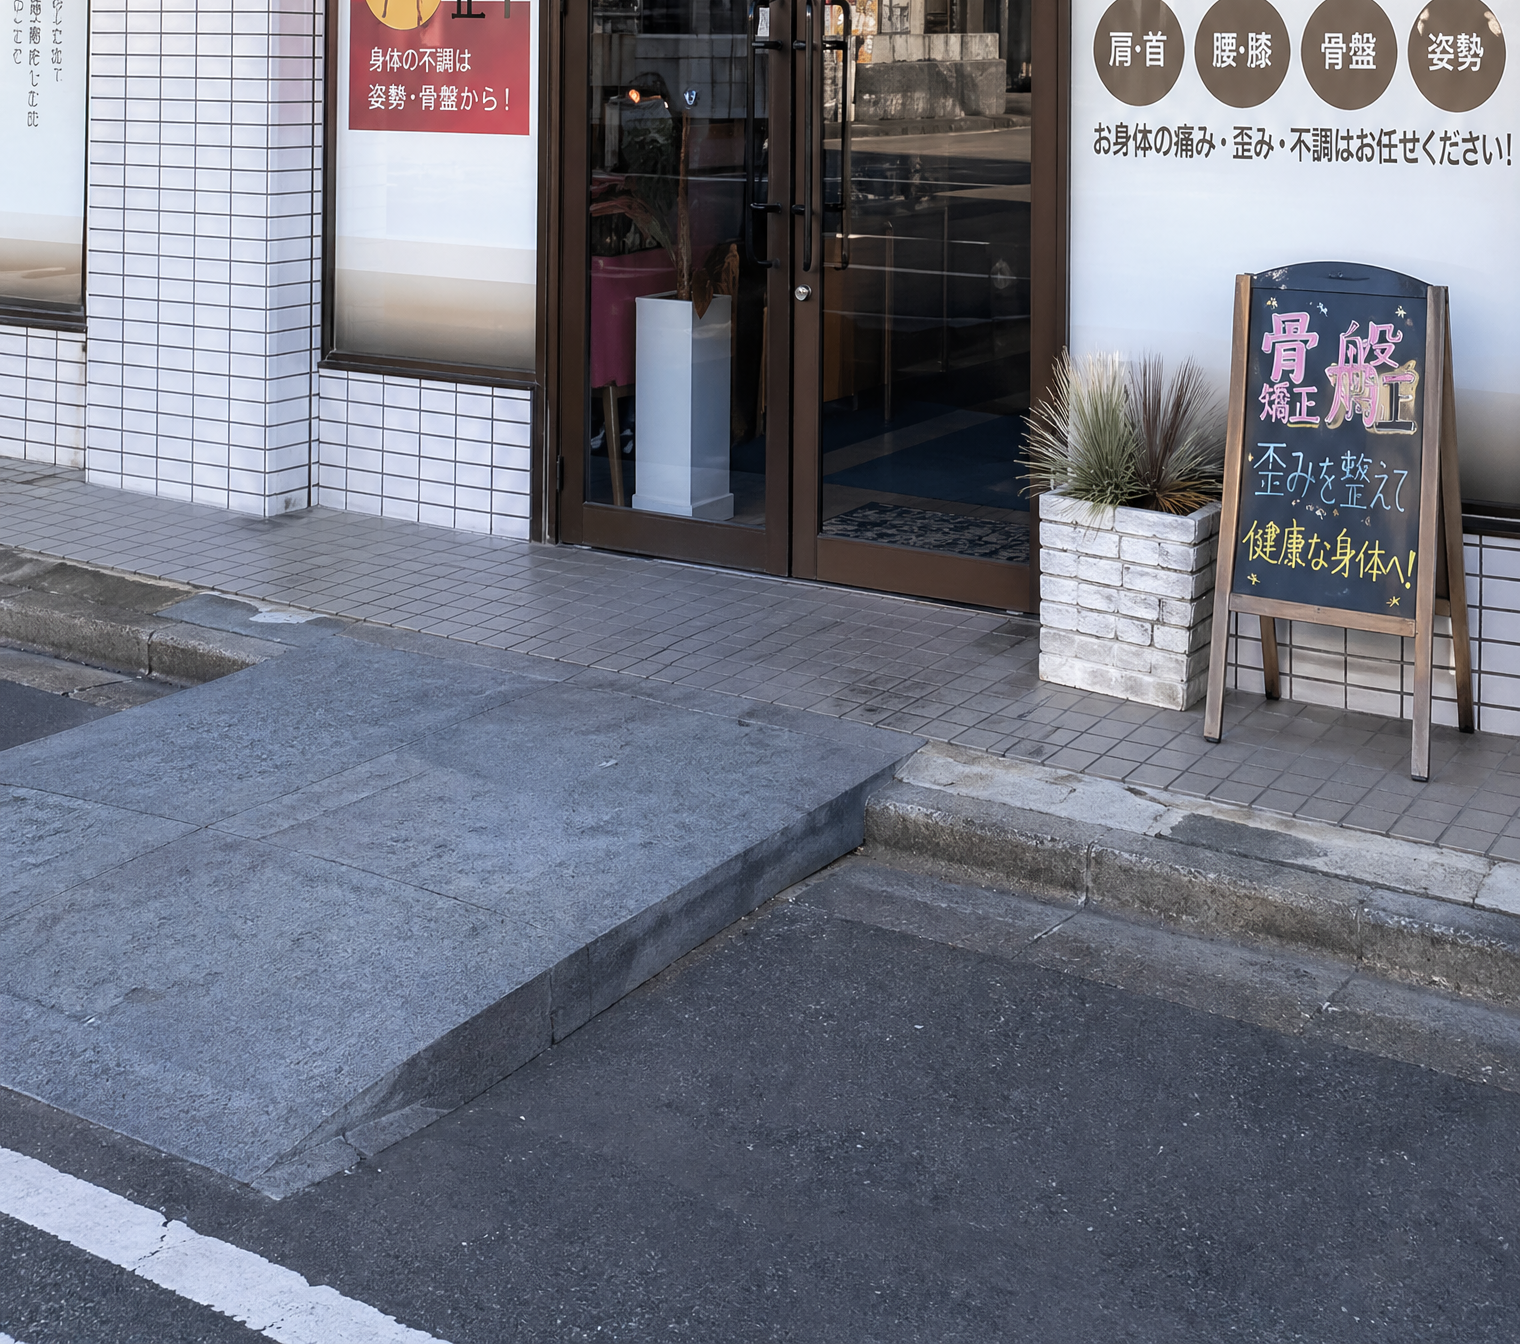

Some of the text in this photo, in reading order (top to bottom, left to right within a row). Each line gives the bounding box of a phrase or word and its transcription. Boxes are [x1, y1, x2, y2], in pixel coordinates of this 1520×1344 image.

[369, 46, 472, 73] 身体の不調は
[1108, 30, 1167, 67] 肩・首
[1212, 31, 1272, 69] 腰・膝
[1321, 31, 1377, 70] 骨盤
[1427, 32, 1484, 72] 姿勢
[1253, 442, 1409, 513] 歪みを整えて
